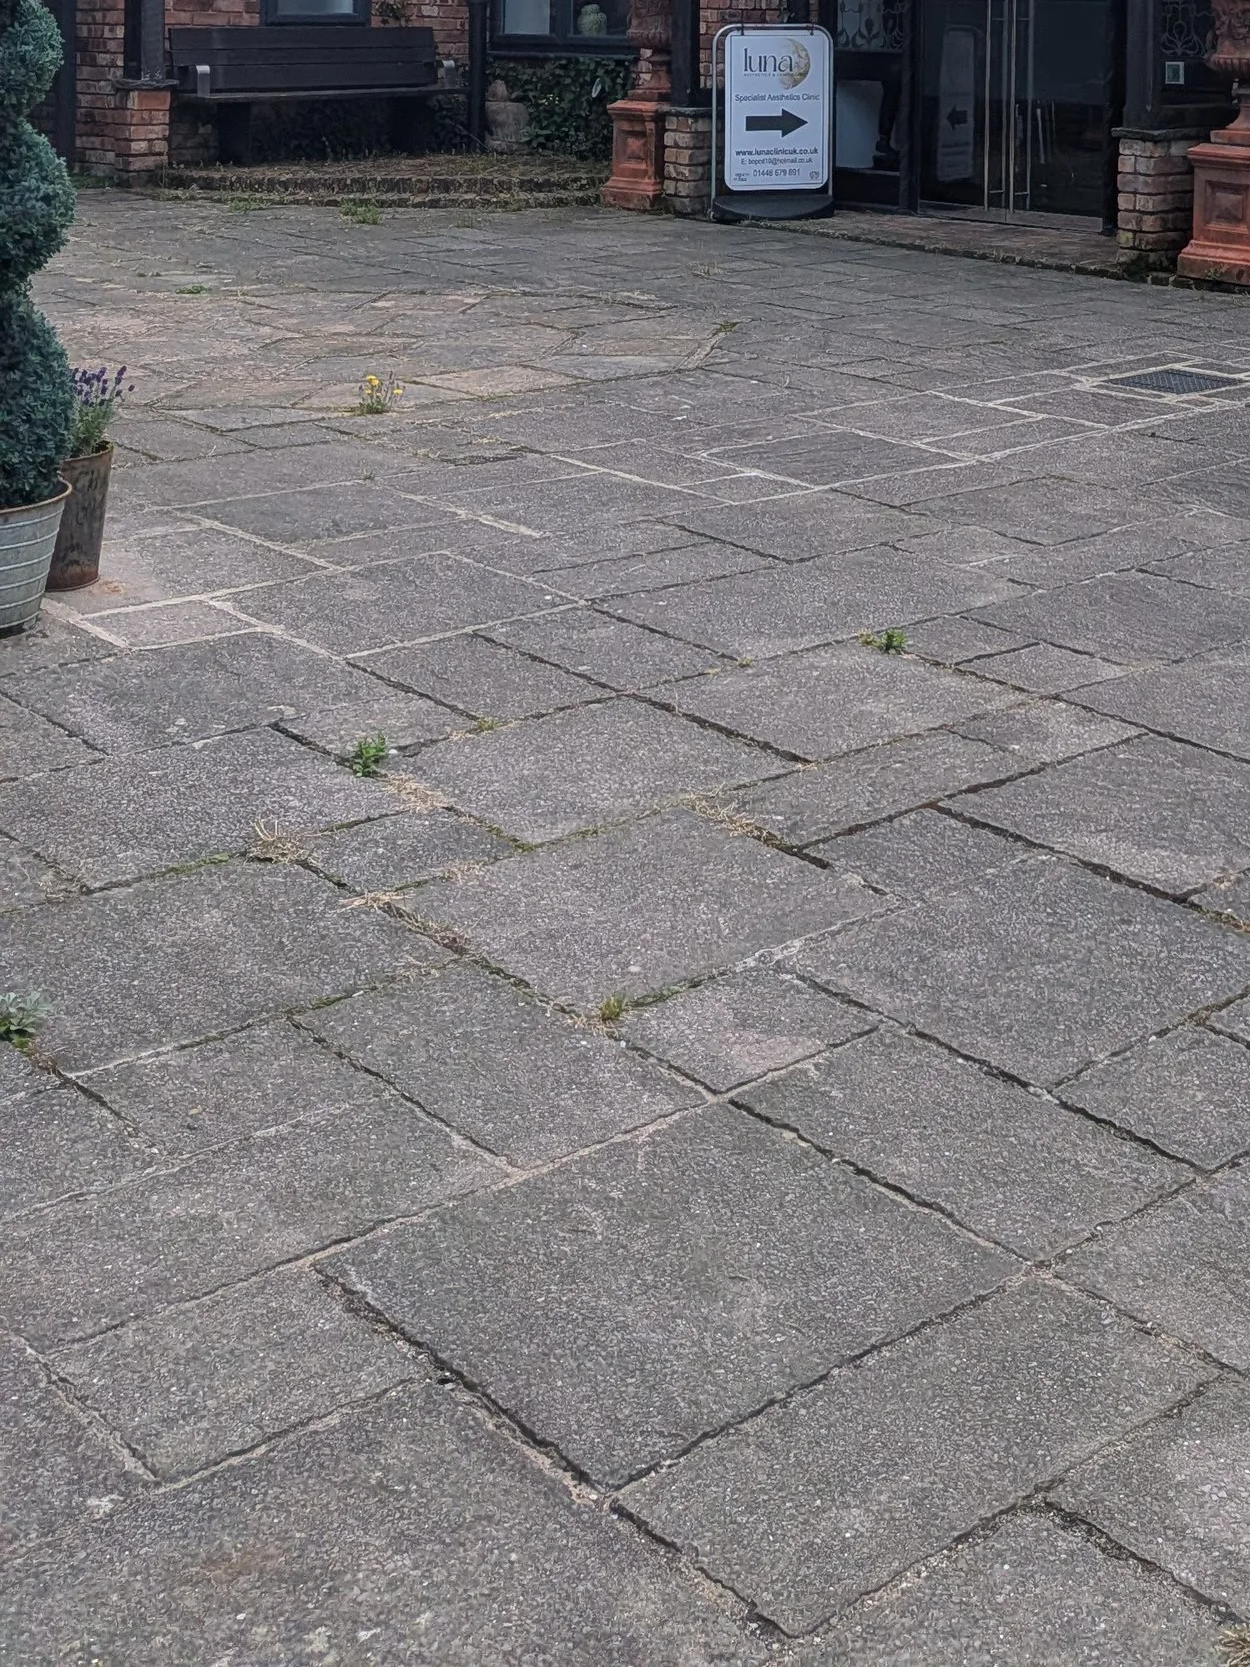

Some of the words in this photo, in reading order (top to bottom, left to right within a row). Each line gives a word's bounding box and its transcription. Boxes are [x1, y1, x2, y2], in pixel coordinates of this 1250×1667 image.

[743, 47, 794, 73] luna
[735, 94, 767, 103] Specialist
[767, 93, 801, 101] Aesthetics
[802, 93, 820, 101] Clinic
[735, 147, 819, 156] www.lunaclinicuk.co.uk
